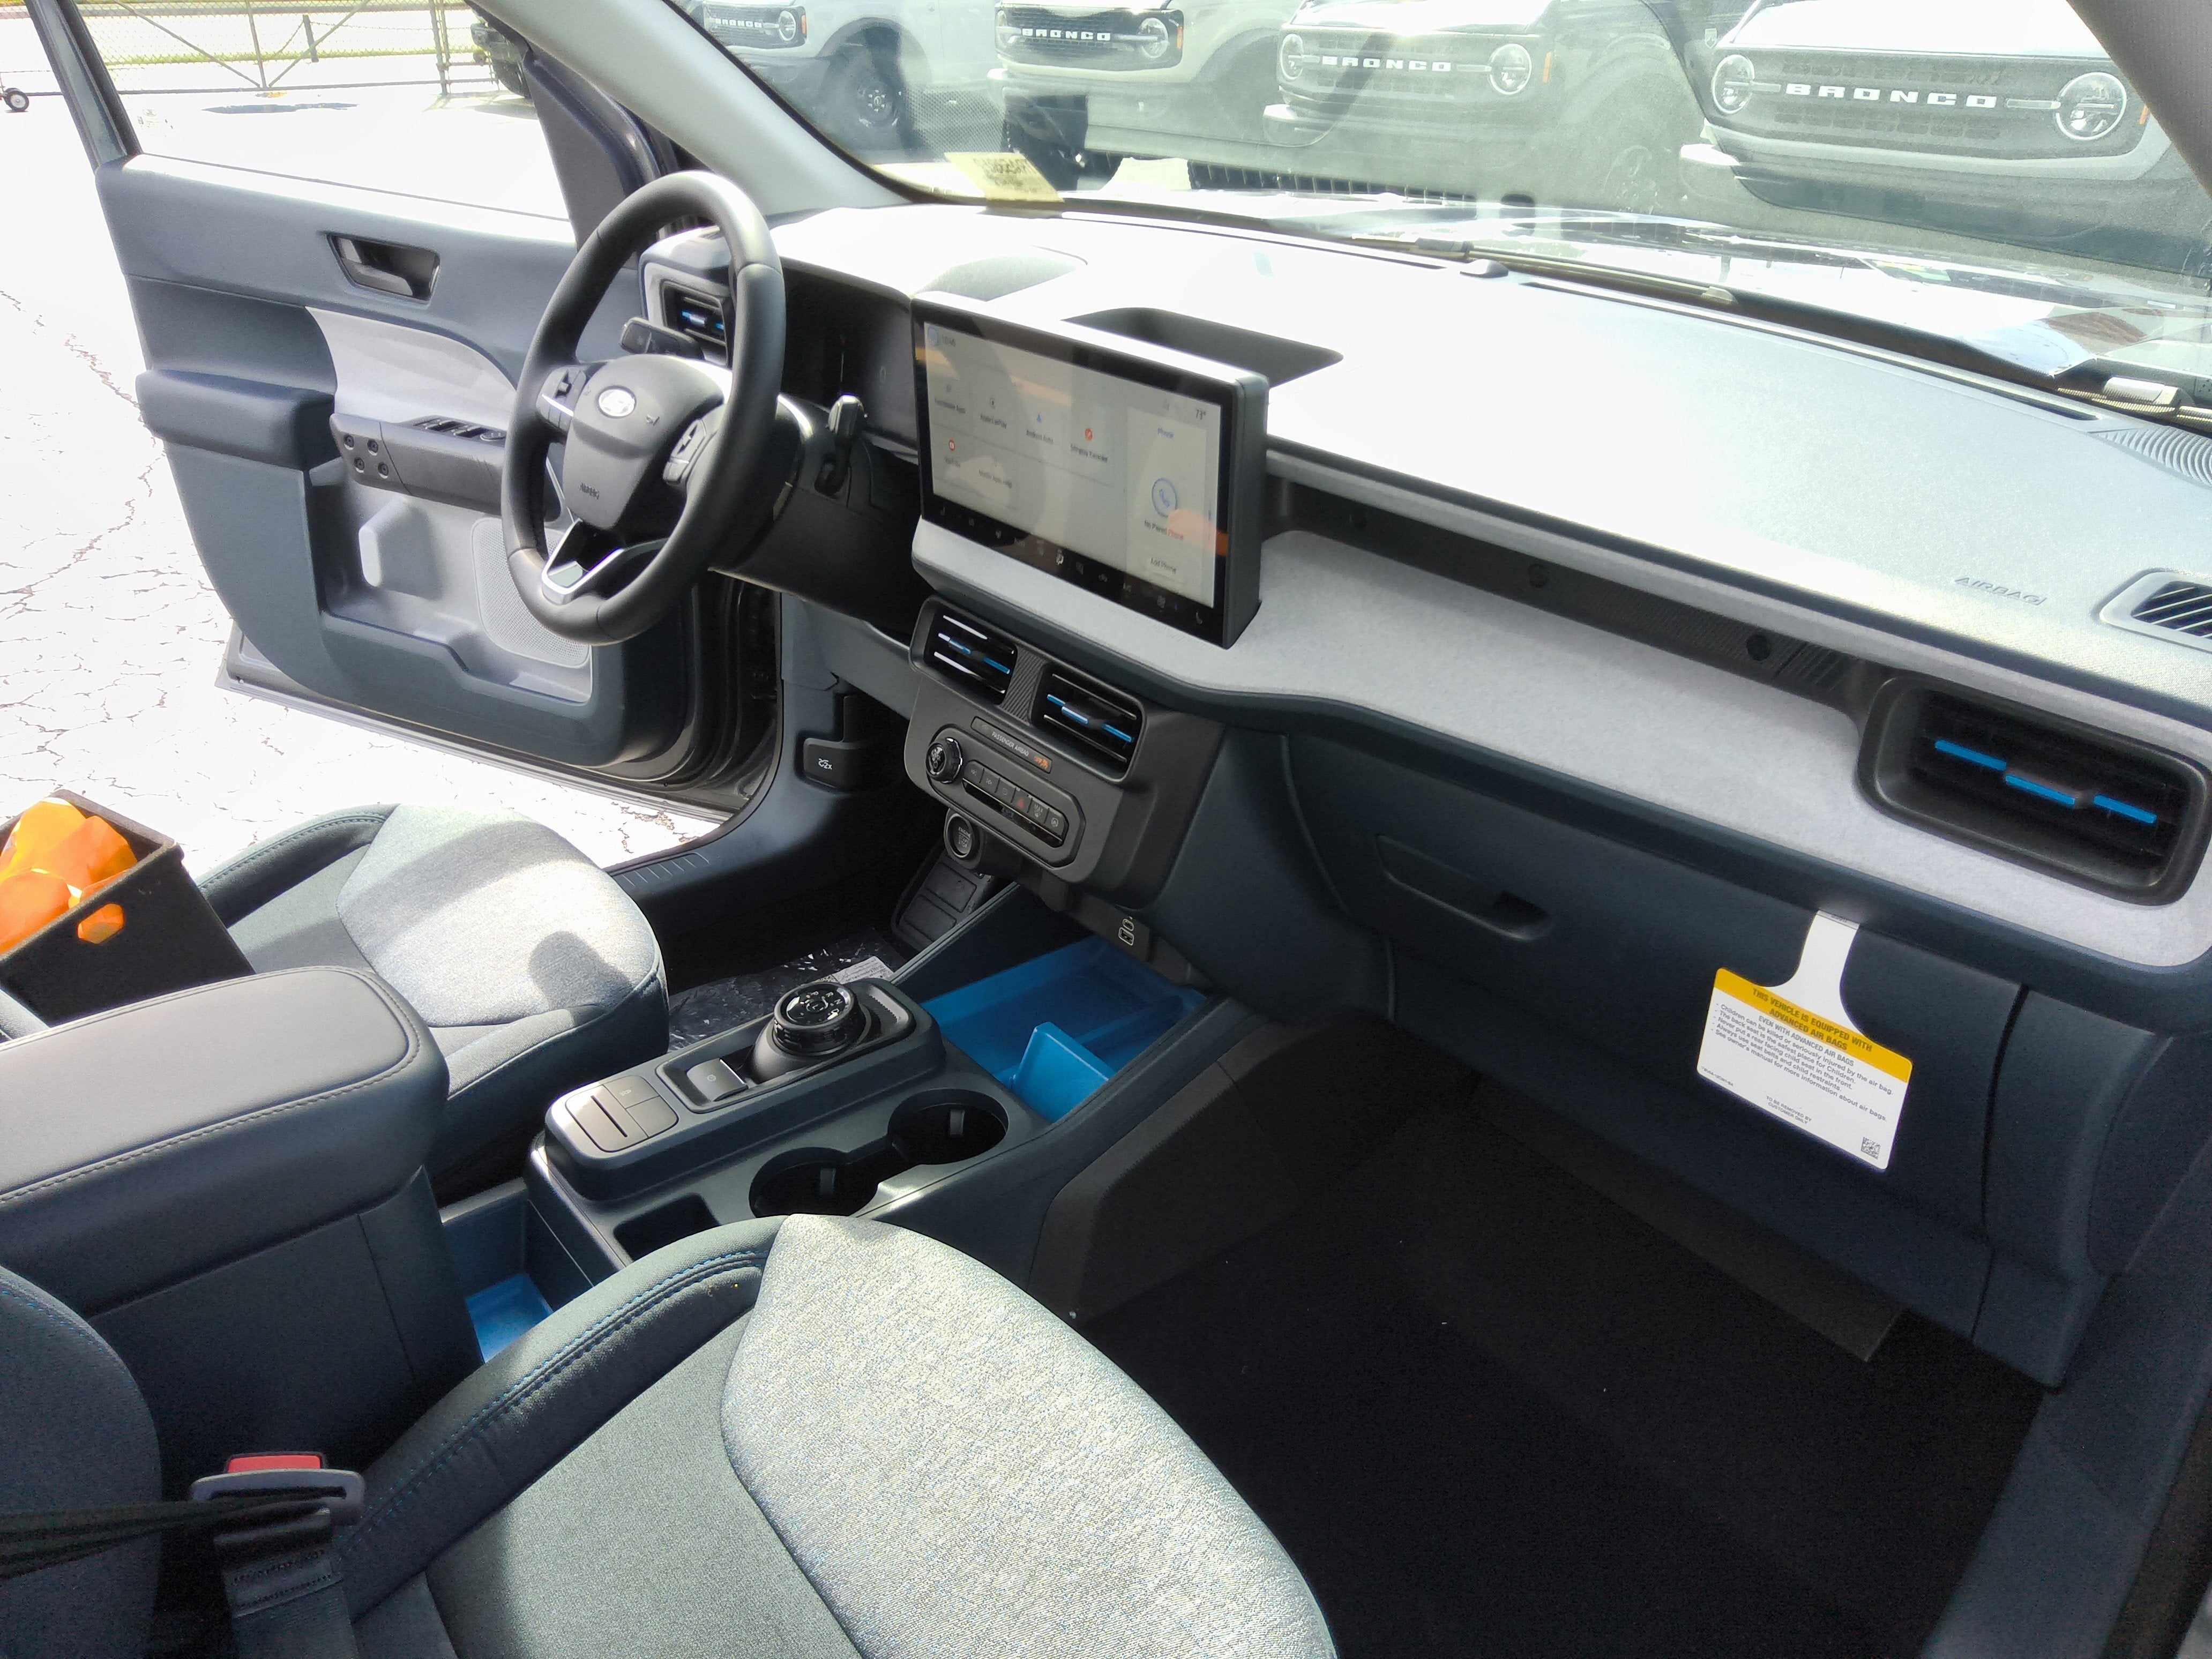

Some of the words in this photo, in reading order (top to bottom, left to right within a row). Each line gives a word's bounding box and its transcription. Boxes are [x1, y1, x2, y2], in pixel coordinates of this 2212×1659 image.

[1022, 28, 1111, 41] BRONCO
[1322, 56, 1451, 72] BRONCO
[1785, 83, 1997, 108] BRONCO
[1953, 577, 2047, 606] AIRBAG
[991, 731, 1015, 749] PASSENGER
[1753, 987, 1769, 1002] THIS
[1769, 996, 1800, 1019] VEHICLE
[1800, 1013, 1810, 1023] IS
[1810, 1018, 1850, 1041] EQUIPPED
[1851, 1036, 1873, 1052] WITH
[1769, 1008, 1809, 1033] ADVANCED
[1810, 1028, 1825, 1041] AIR
[1826, 1034, 1848, 1051] BAGS
[1758, 1015, 1774, 1027] EVEN
[1775, 1023, 1790, 1036] WITH
[1790, 1033, 1824, 1052] ADVANCED
[1824, 1049, 1836, 1058] AIR
[1837, 1054, 1854, 1066] BAGS
